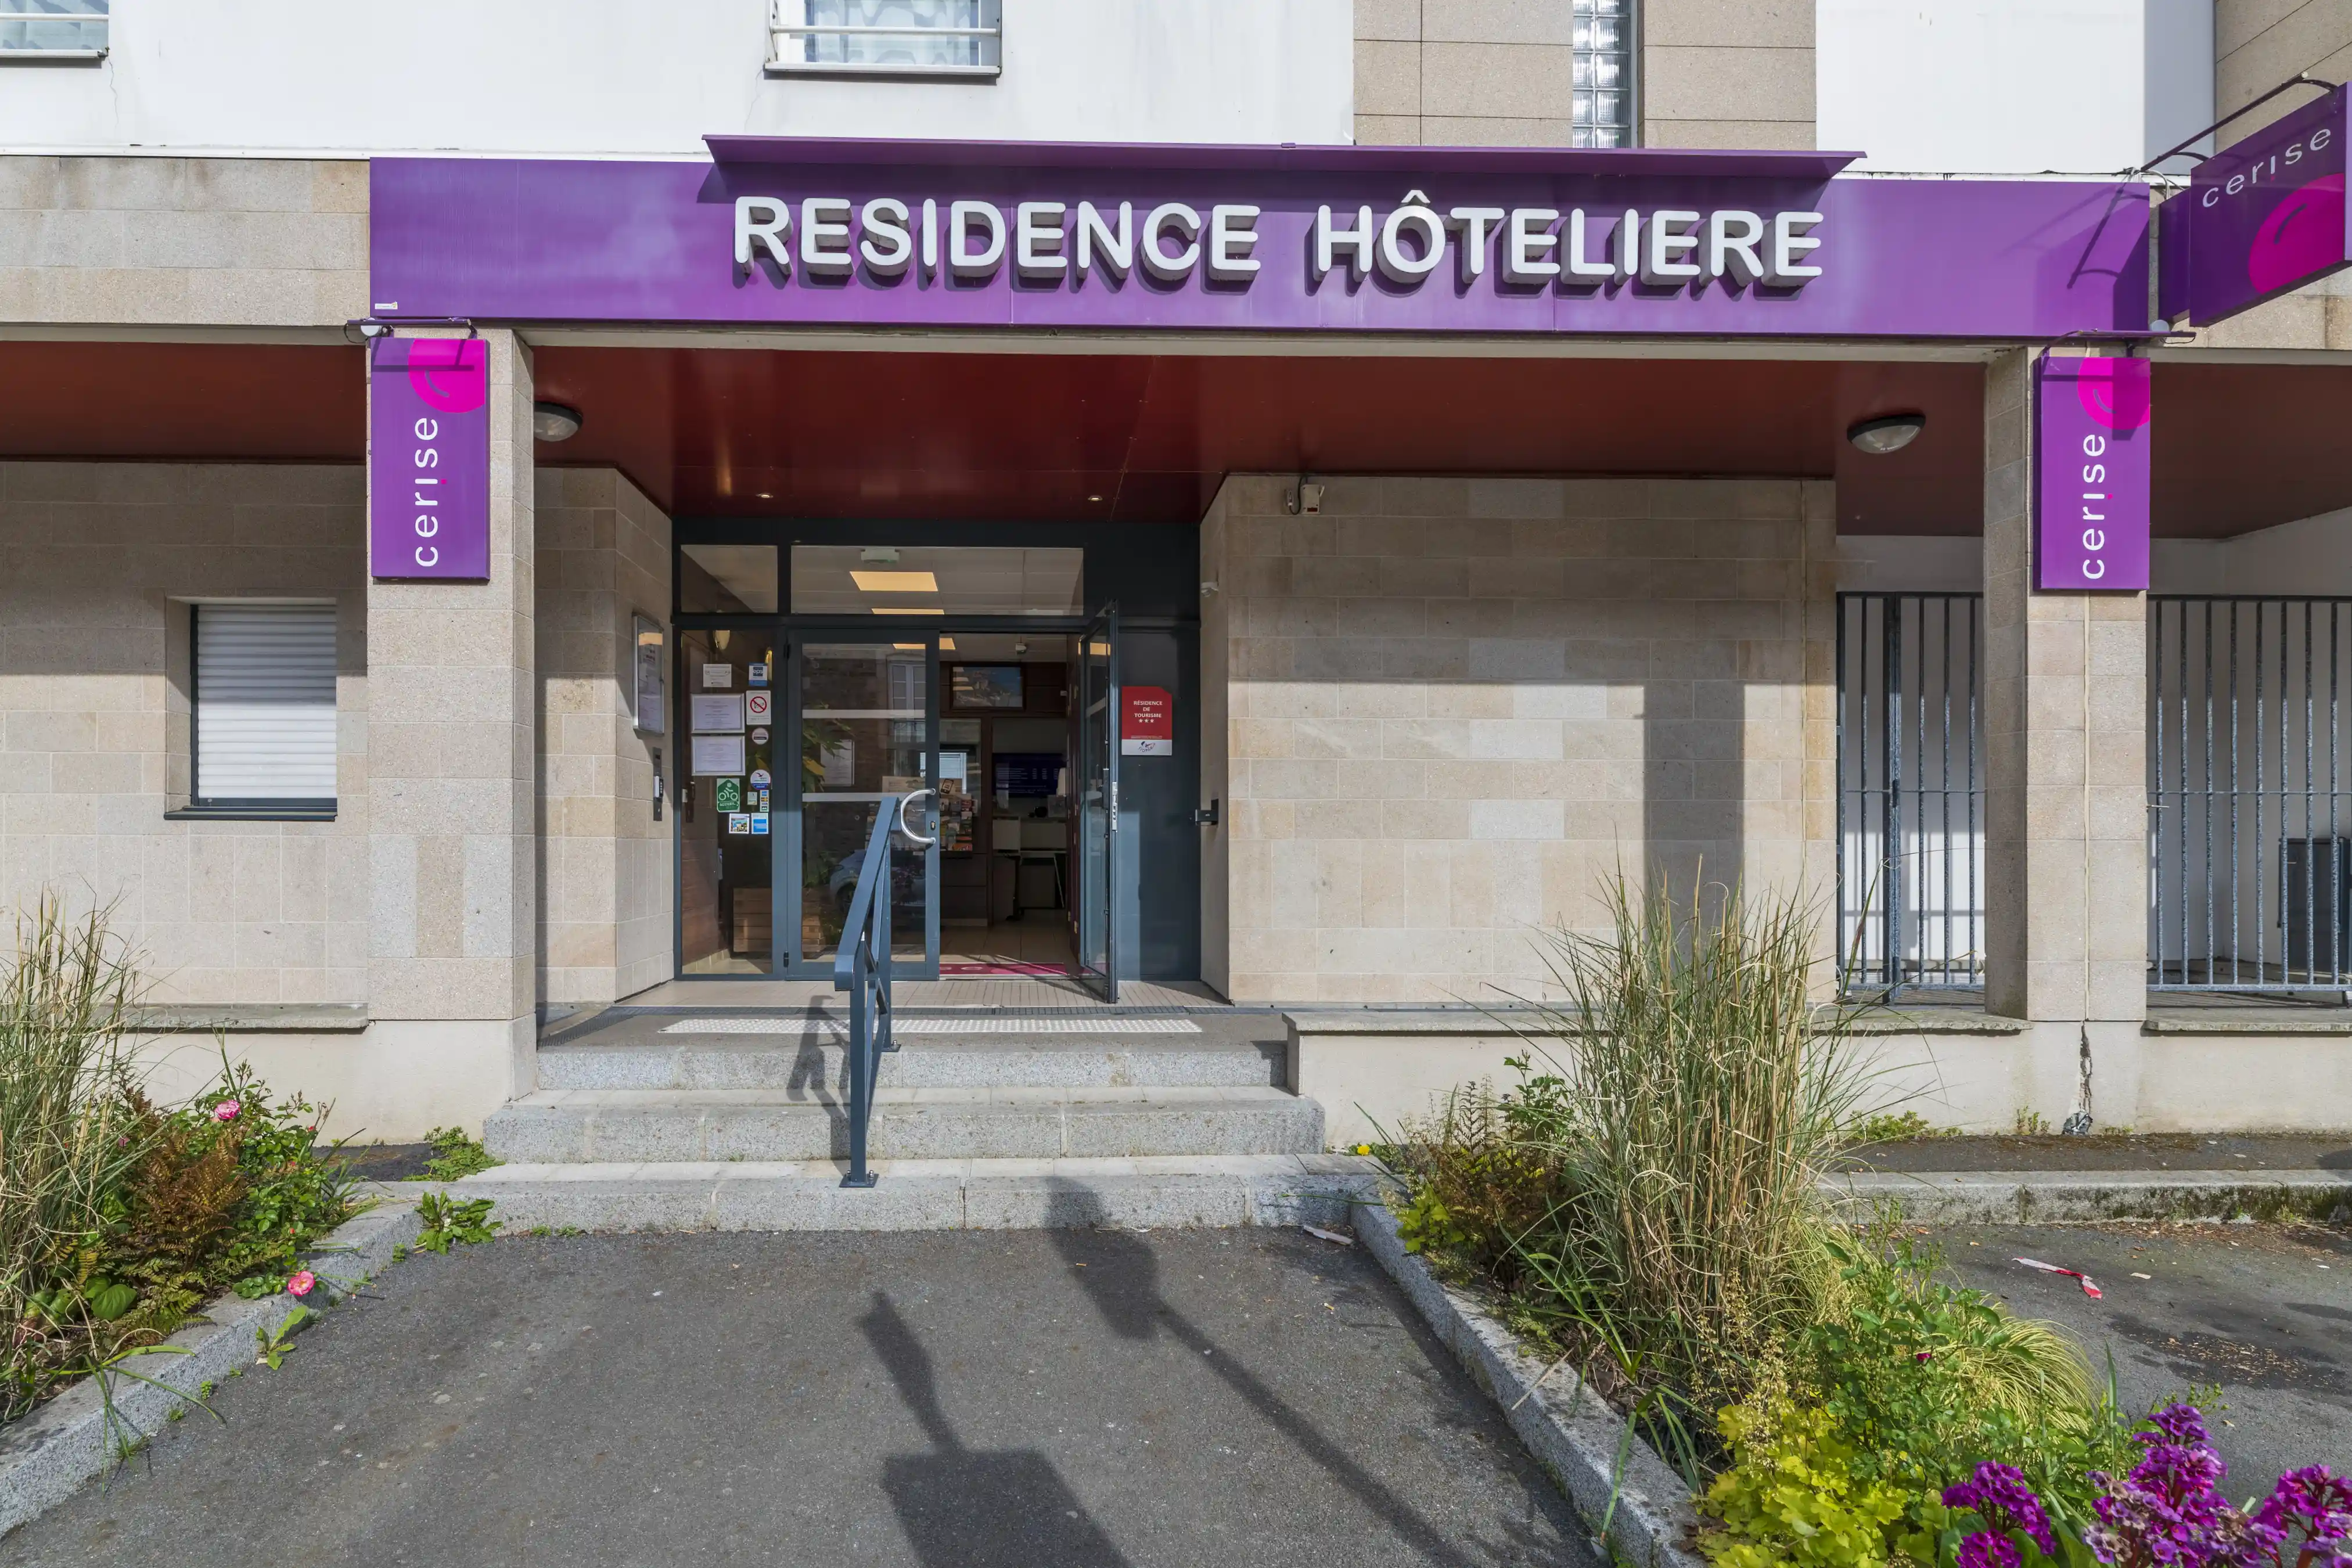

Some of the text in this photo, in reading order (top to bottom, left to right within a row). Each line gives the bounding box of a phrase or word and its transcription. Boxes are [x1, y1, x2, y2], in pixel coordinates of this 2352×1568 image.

[2202, 127, 2332, 208] cerise
[734, 190, 1824, 276] RESIDENCE HÔTELIERE
[415, 416, 447, 567] cerise
[2082, 434, 2113, 579] cerise
